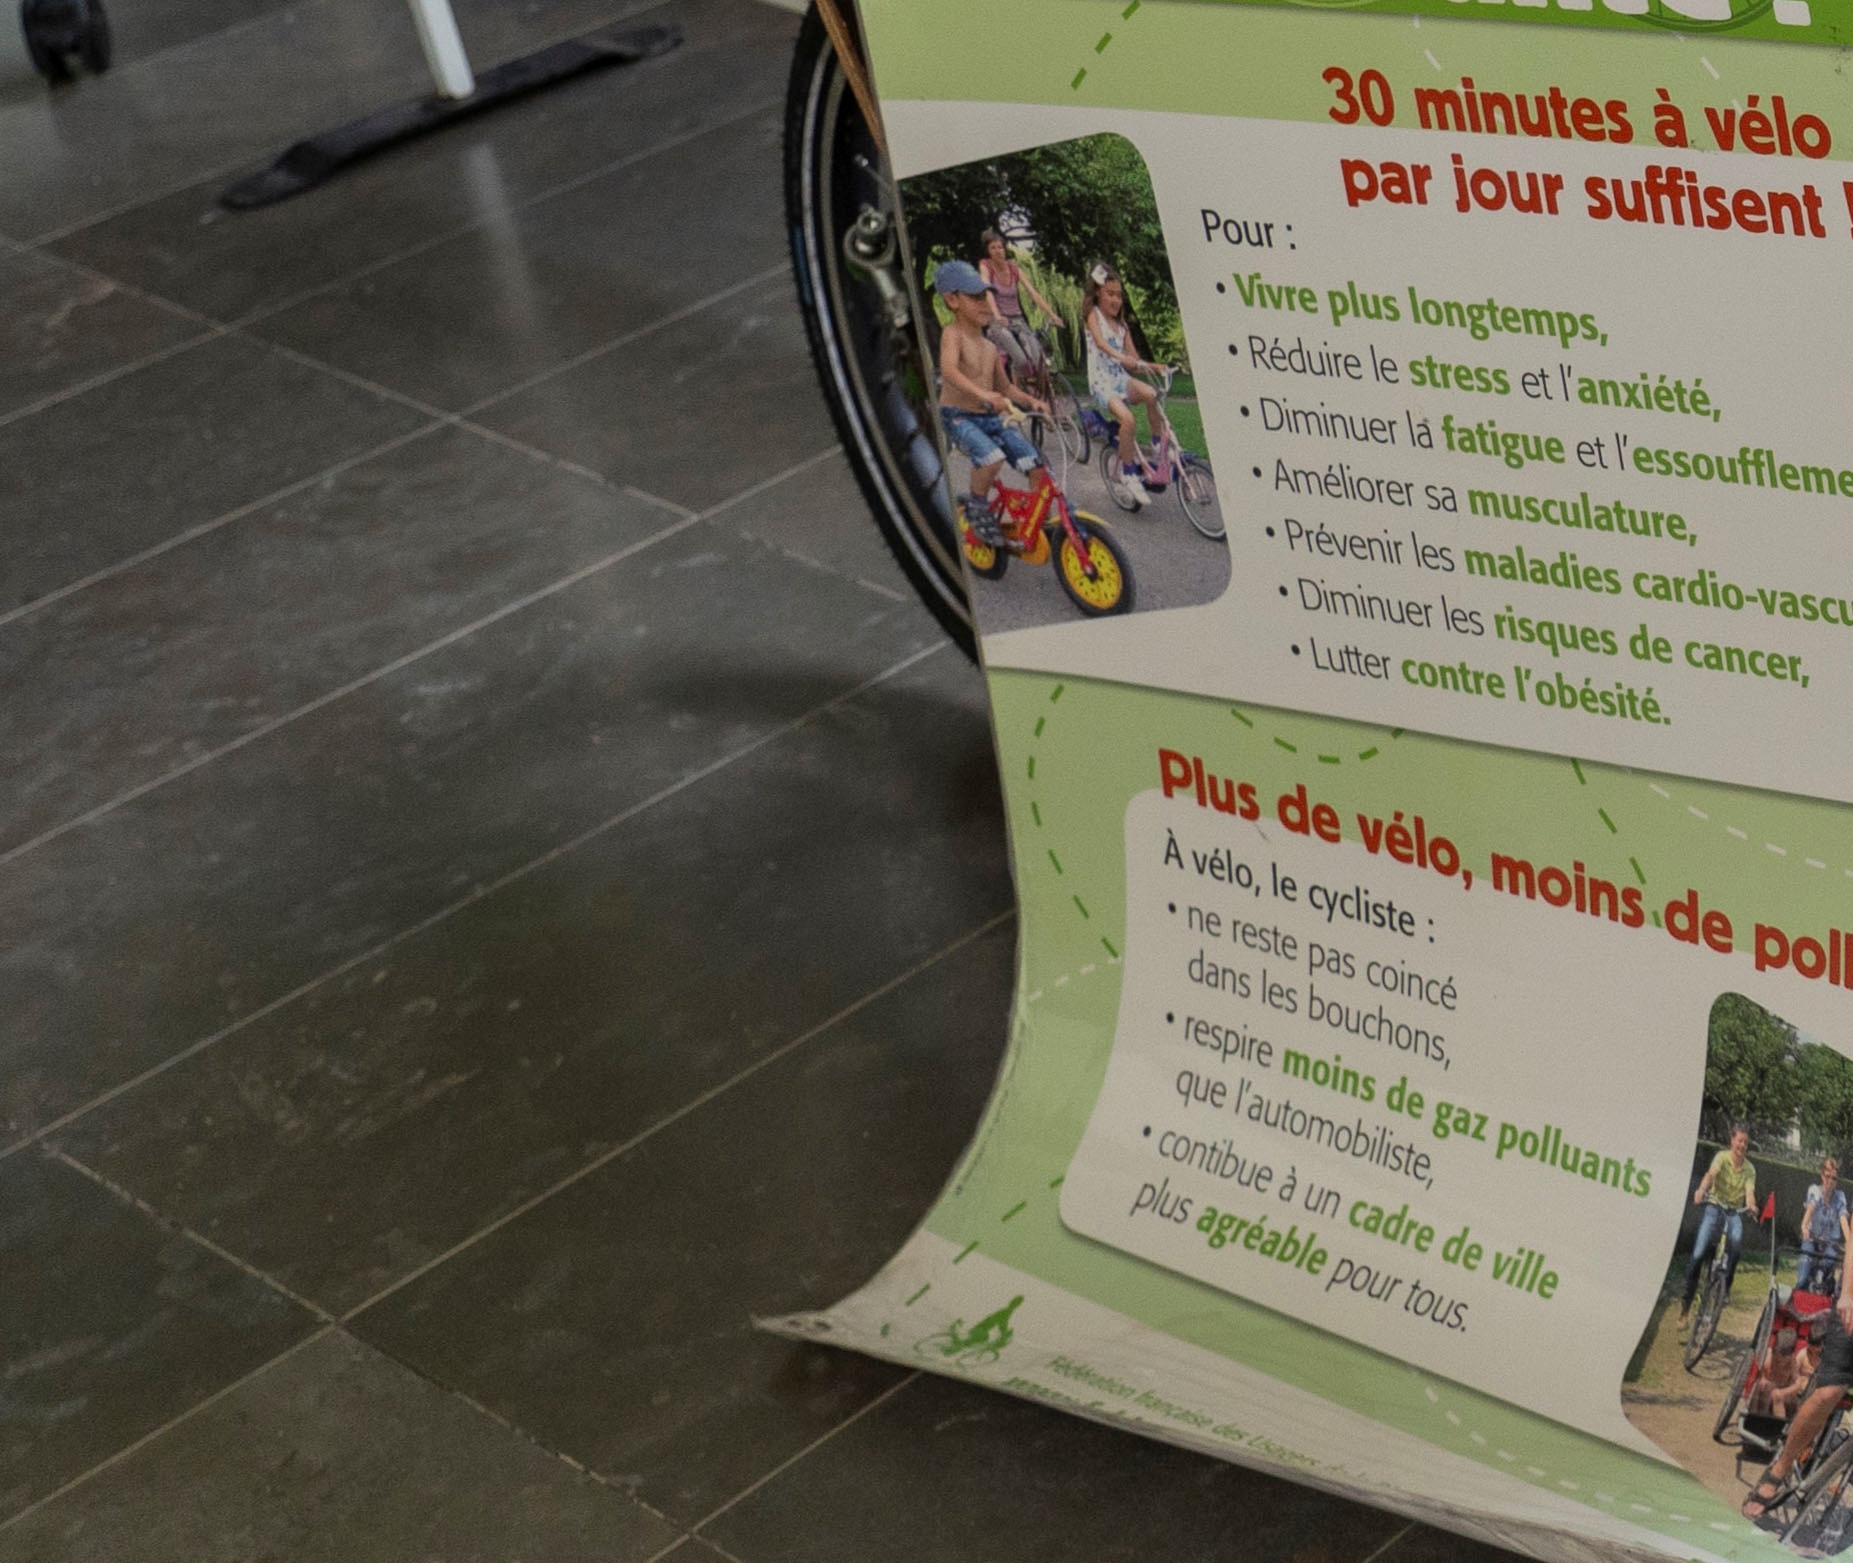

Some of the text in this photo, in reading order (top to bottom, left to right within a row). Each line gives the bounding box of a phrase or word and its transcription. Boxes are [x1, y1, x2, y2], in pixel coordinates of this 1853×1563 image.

[1320, 65, 1833, 160] 30 minutes à vélo
[1200, 208, 1276, 251] Pour
[1339, 155, 1429, 209] par
[1449, 152, 1565, 216] jour
[1586, 165, 1826, 239] suffisent
[1232, 272, 1609, 347] Vivre plus longtemps,
[1247, 333, 1723, 423] Réduire le stress et l'anxiété,
[1260, 396, 1399, 450] Diminuer
[1405, 409, 1435, 451] la
[1440, 414, 1567, 470] fatigue
[1575, 436, 1607, 470] et
[1273, 457, 1699, 546] Améliorer sa musculature,
[1284, 516, 1405, 568] Prévenir
[1410, 531, 1457, 574] les
[1463, 544, 1623, 596] maladies
[1297, 576, 1810, 690] Diminuer les risques de cancer,
[1310, 636, 1672, 727] Lutter contre l'obésité.
[1156, 747, 1262, 825] Plus
[1274, 783, 1343, 845] de
[1356, 809, 1474, 892] vélo,
[1490, 846, 1647, 930] moins
[1663, 890, 1735, 955] de
[1163, 826, 1416, 942] À vélo, le cycliste
[1186, 904, 1459, 1013] ne reste pas coincé
[1187, 947, 1452, 1071] dans les bouchons,
[1174, 1067, 1436, 1190] que l'automobiliste,
[1184, 1010, 1653, 1199] respire moins de gaz polluants
[1129, 1176, 1469, 1333] plus agréable pour tous.
[1158, 1125, 1560, 1300] contibue à un cadre de ville
